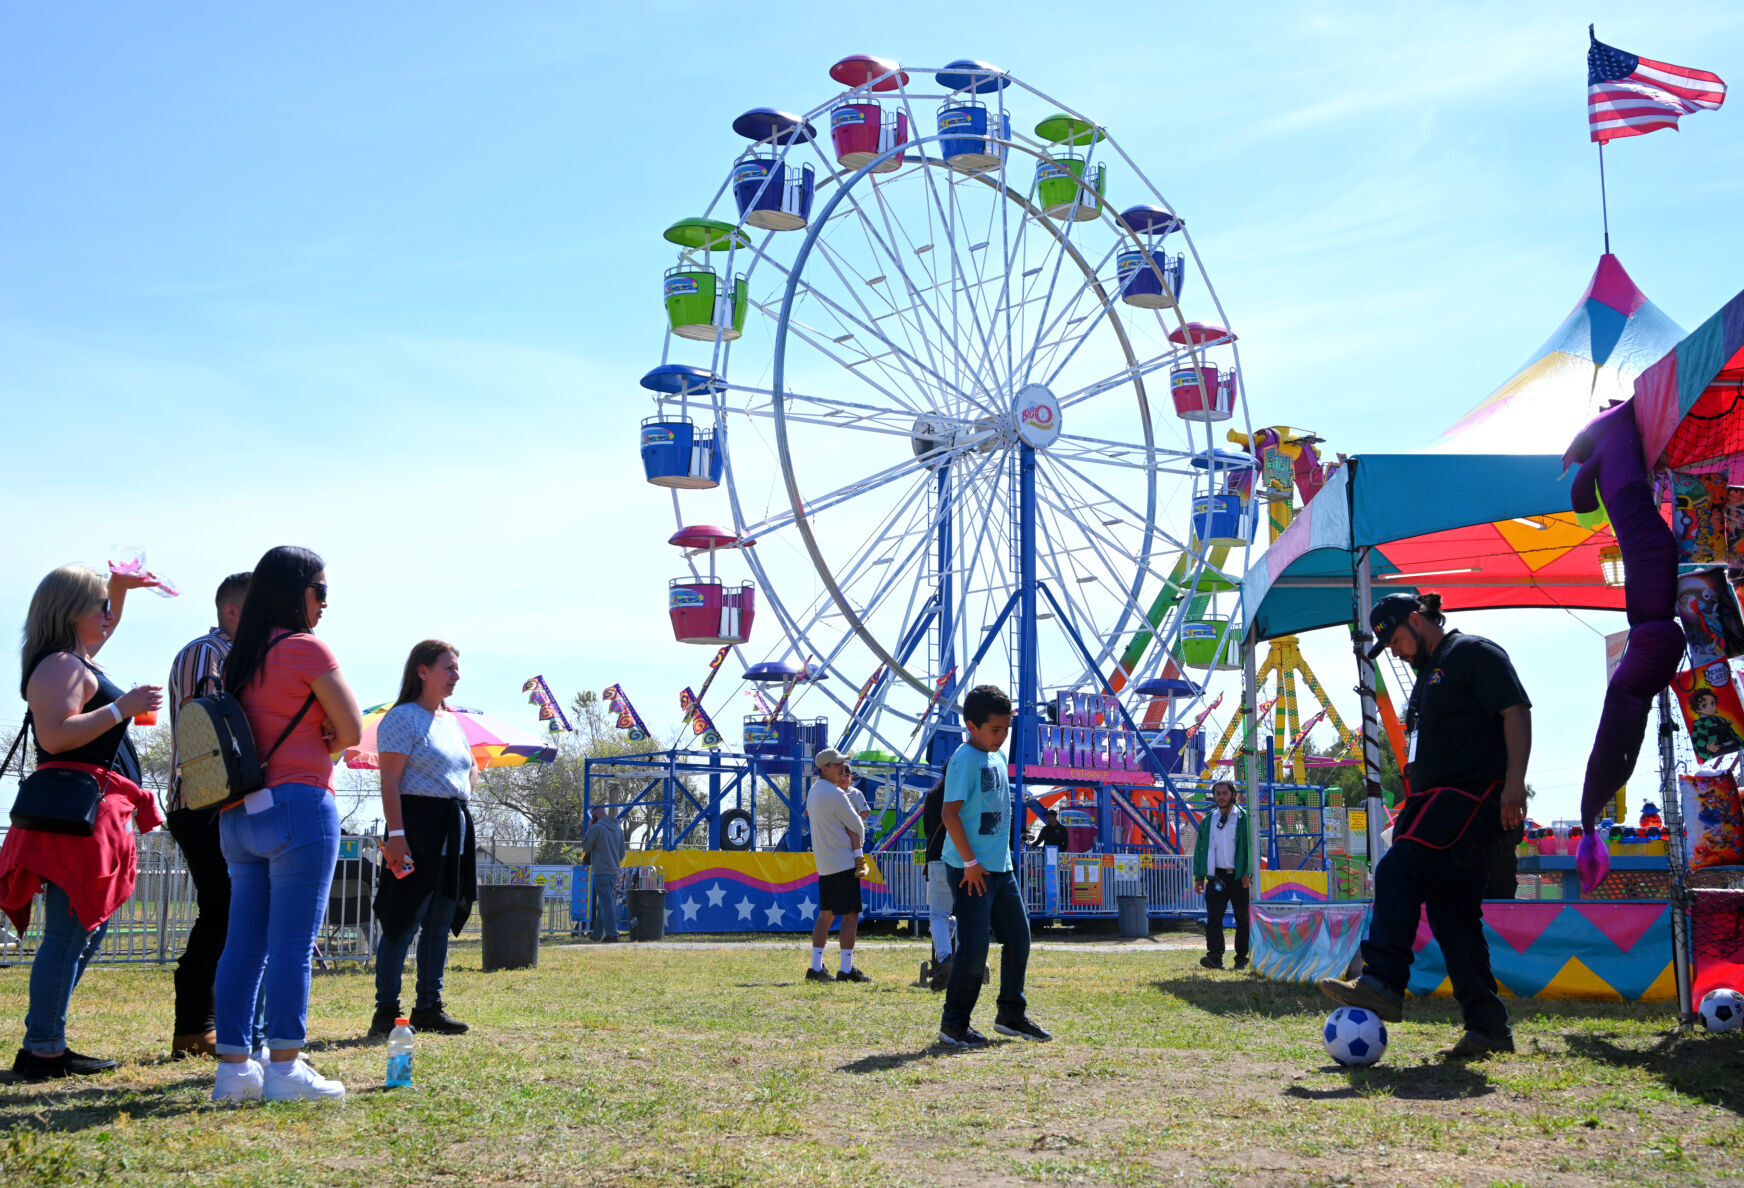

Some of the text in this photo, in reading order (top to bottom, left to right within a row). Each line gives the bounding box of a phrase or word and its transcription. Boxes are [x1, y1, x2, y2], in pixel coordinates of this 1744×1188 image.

[1022, 405, 1053, 424] BIG O
[1058, 691, 1120, 728] EXPO
[1039, 725, 1138, 771] WHEEL
[1070, 769, 1109, 779] ENTRANCE
